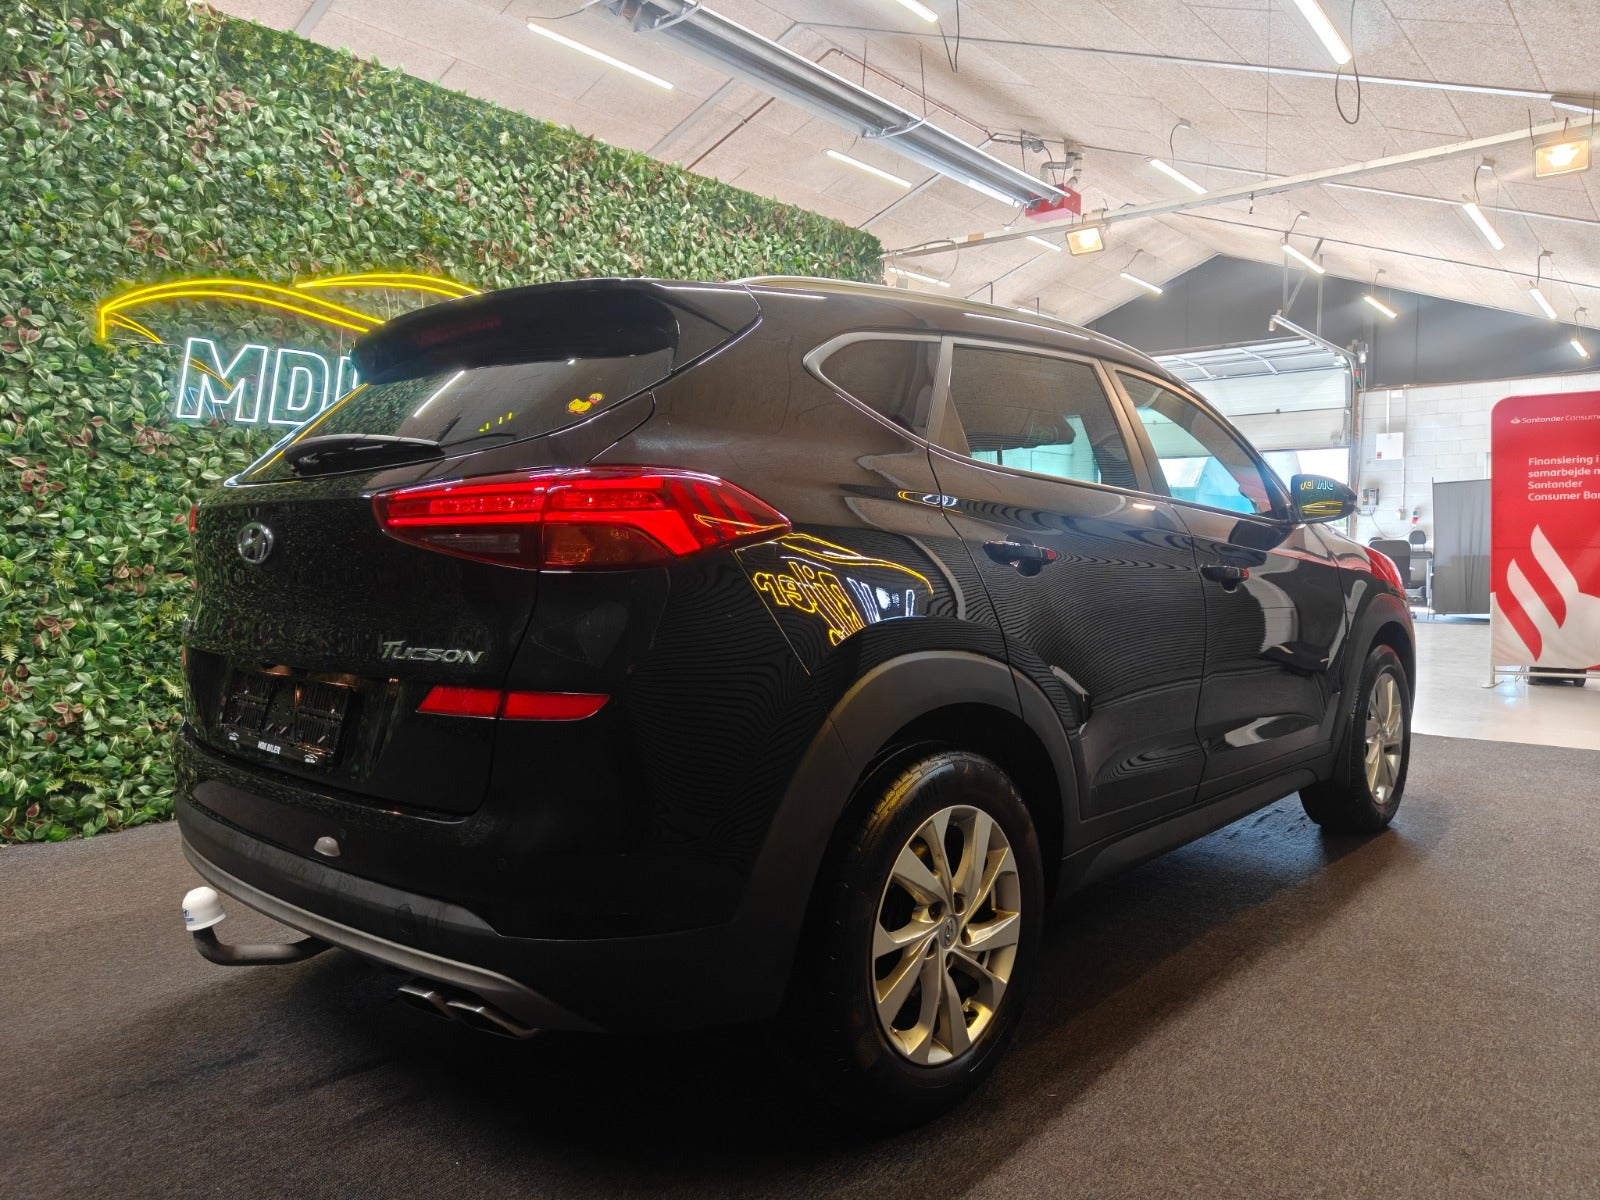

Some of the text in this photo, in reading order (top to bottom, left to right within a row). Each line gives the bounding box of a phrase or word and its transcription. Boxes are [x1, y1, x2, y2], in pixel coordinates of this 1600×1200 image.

[1521, 415, 1564, 424] Santander
[1528, 455, 1593, 466] Finansiering
[1528, 467, 1591, 478] samarbejde
[1528, 480, 1583, 489] Santander
[1528, 492, 1581, 501] Consumer
